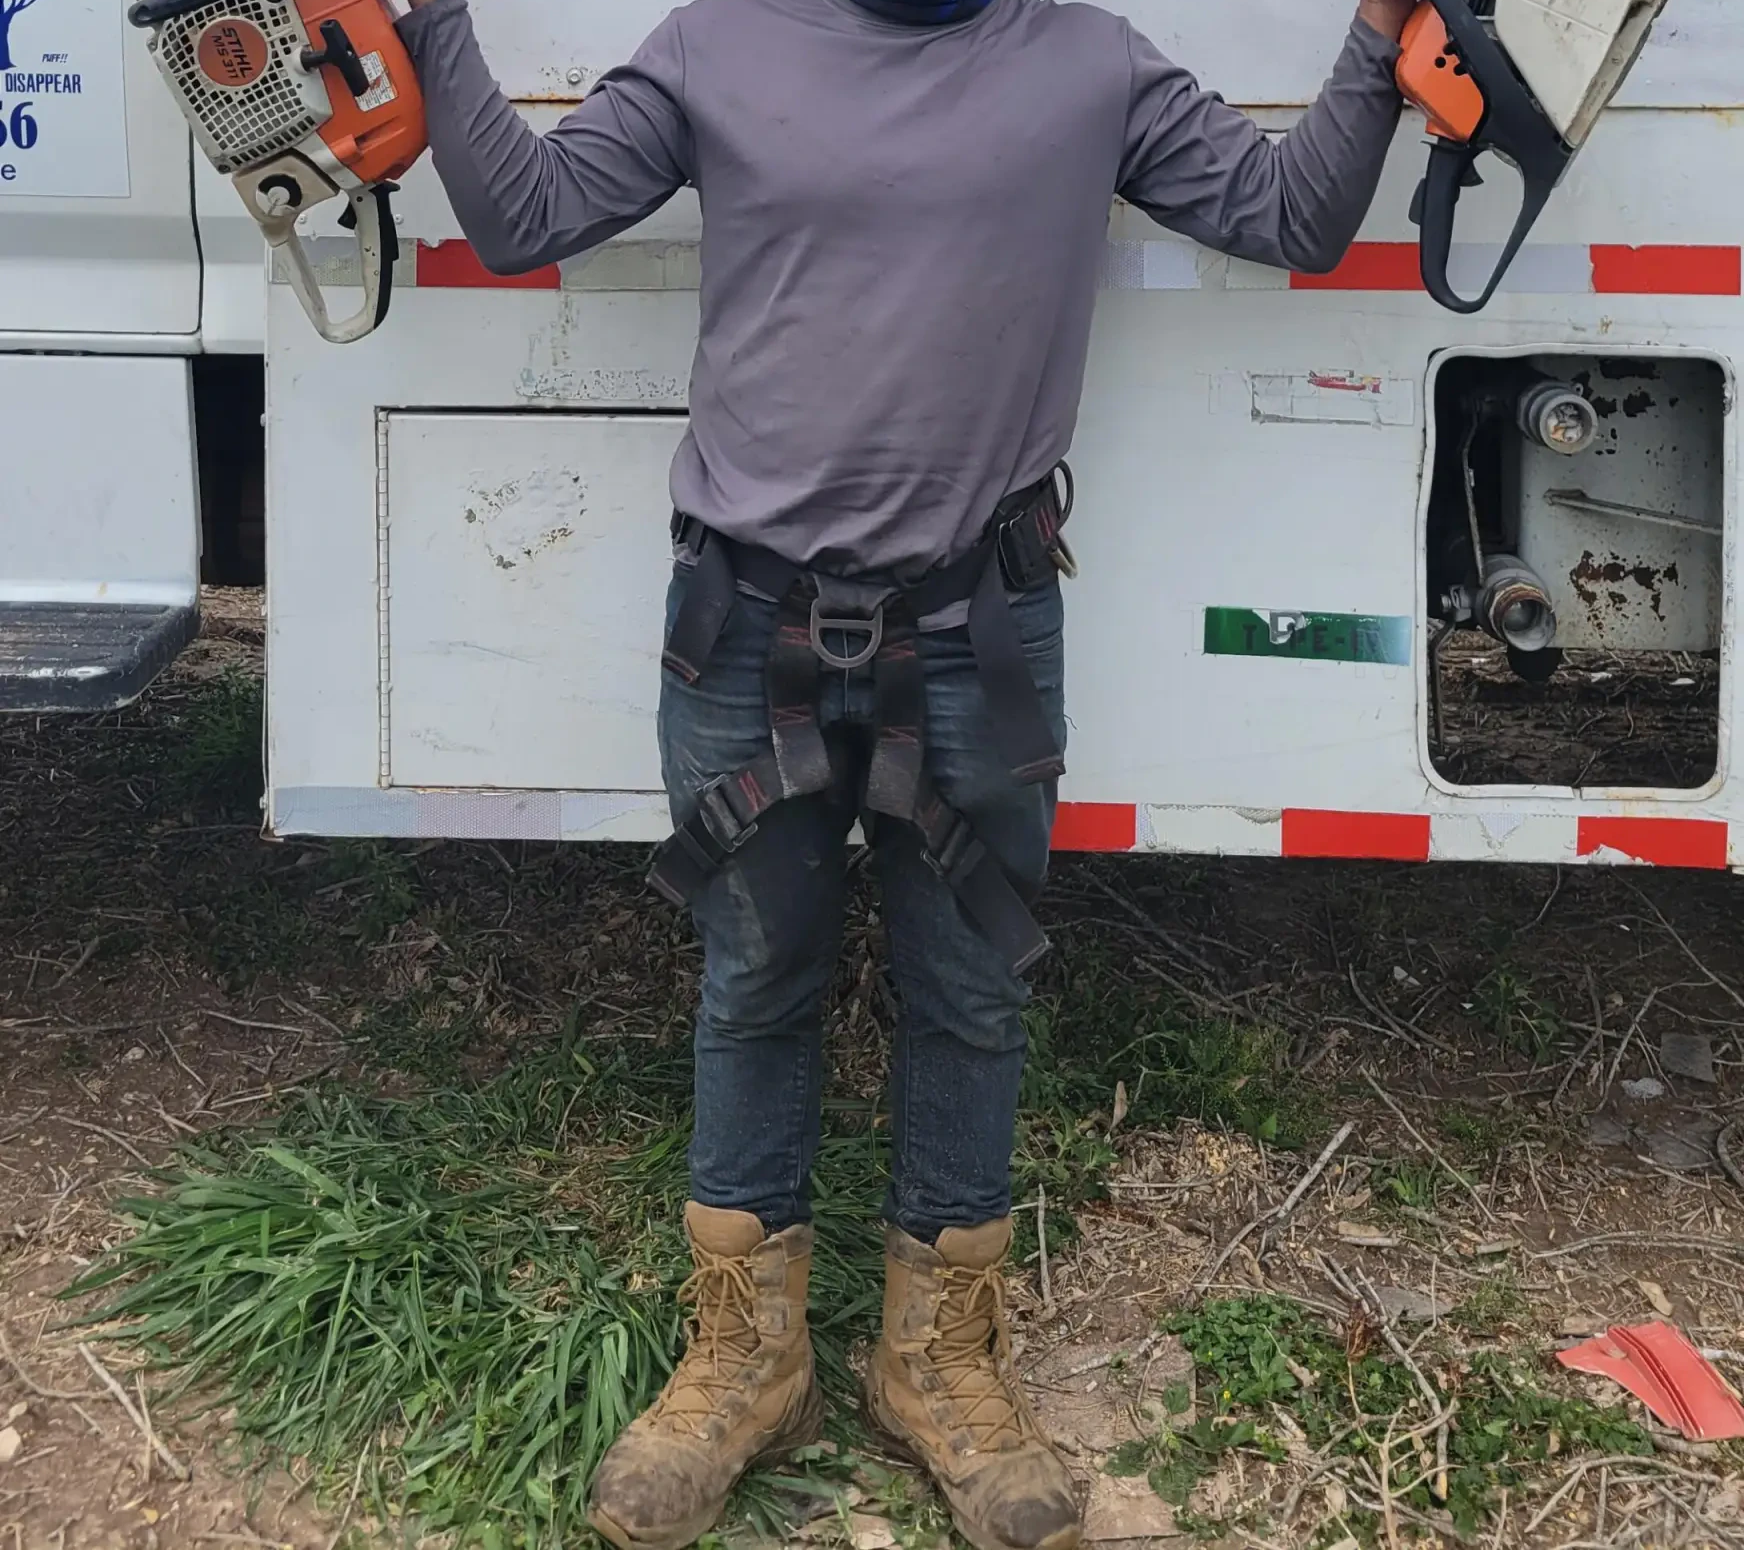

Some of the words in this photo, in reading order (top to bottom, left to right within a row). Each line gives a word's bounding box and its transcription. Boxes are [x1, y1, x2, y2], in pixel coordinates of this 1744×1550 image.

[211, 35, 230, 57] MS
[222, 58, 240, 79] 311
[222, 27, 253, 79] STIHL
[5, 72, 82, 94] DISAPPEAR
